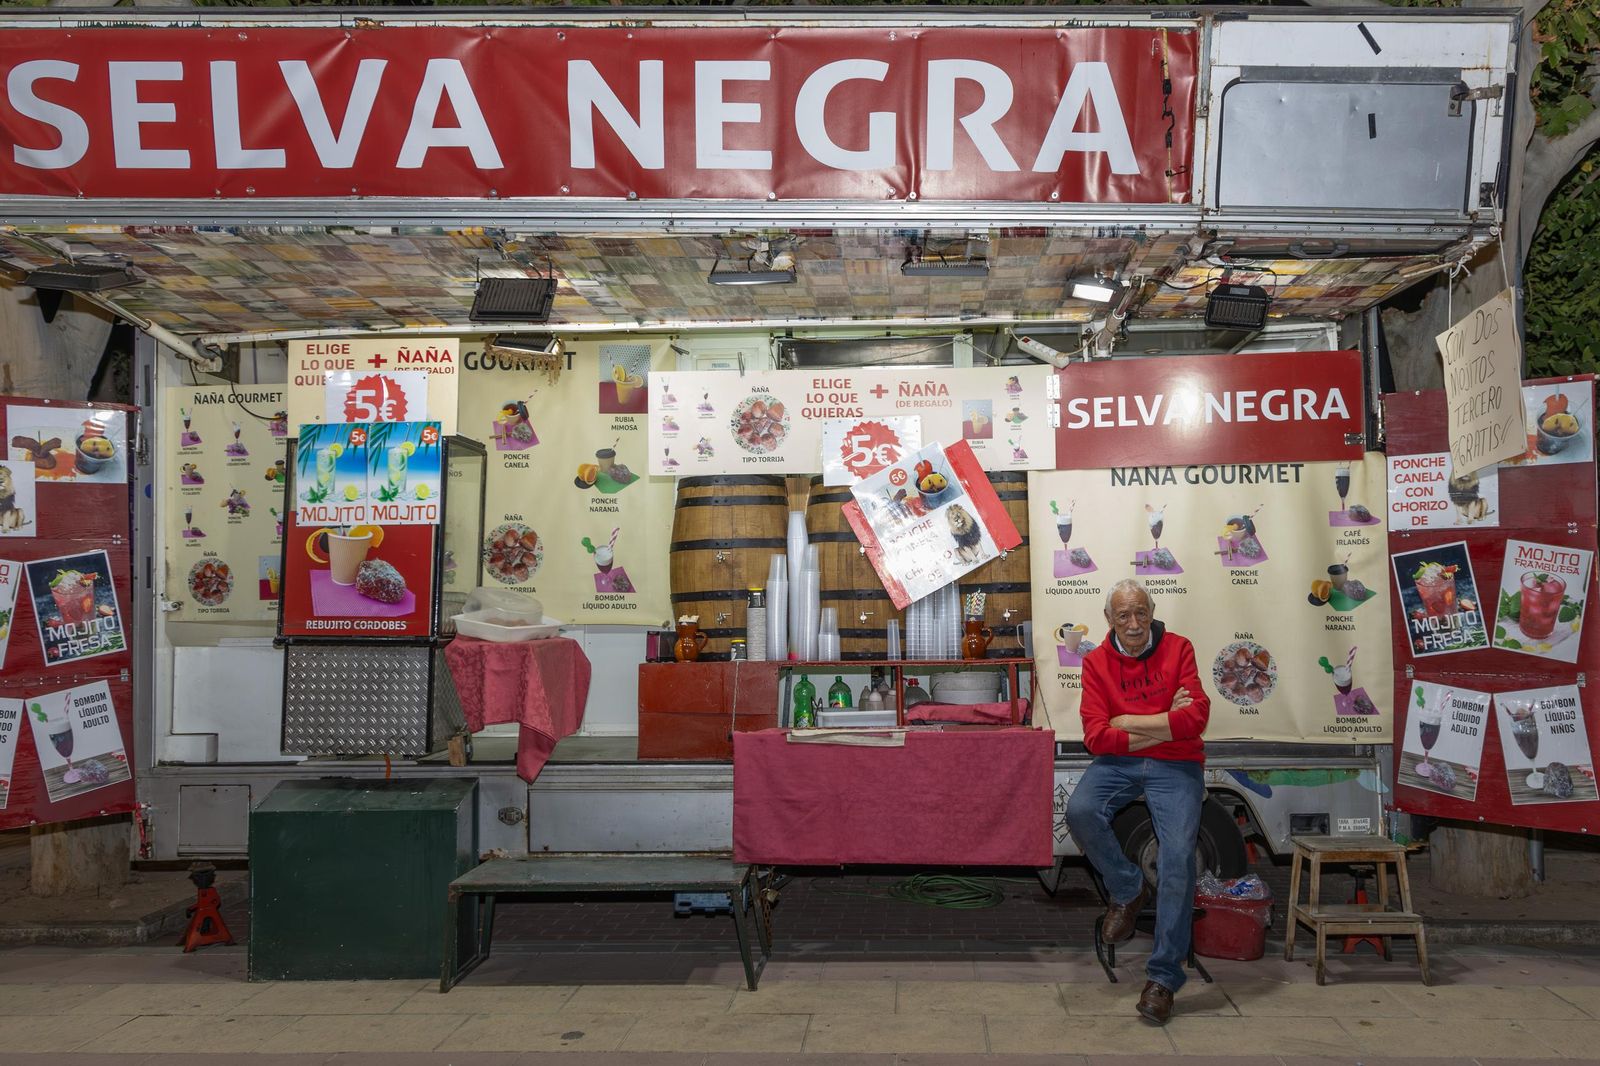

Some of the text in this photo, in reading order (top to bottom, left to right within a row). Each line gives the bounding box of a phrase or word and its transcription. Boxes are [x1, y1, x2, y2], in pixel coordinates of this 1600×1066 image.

[6, 58, 1141, 175] SELVA NEGRA
[1472, 307, 1503, 344] DOS
[306, 343, 350, 355] ELIGE
[397, 346, 453, 363] ÑAÑA
[301, 359, 355, 370] LO QUE
[295, 375, 326, 387] QUIE
[812, 378, 852, 390] ELIGE
[898, 381, 950, 397] ÑAÑA
[194, 392, 283, 405] ÑAÑA GOURMET
[806, 392, 859, 404] LO QUE
[1067, 387, 1350, 430] SELVA NEGRA
[1454, 385, 1503, 427] TERCERO
[801, 407, 864, 420] QUIERAS
[351, 431, 366, 442] 5€
[422, 429, 438, 441] 5€
[850, 434, 893, 468] 5€
[742, 456, 758, 464] TIPO
[1393, 456, 1446, 470] PONCHE
[891, 470, 906, 484] 5€
[1184, 464, 1304, 485] GOURMET
[1394, 473, 1445, 484] CANELA
[1405, 486, 1434, 498] CON
[300, 504, 437, 523] MOJITO MOJITO
[1392, 500, 1448, 513] CHORIZO
[1412, 516, 1429, 526] DE
[1518, 545, 1580, 566] MOJITO
[1514, 557, 1580, 576] FRAMBUESA
[46, 614, 115, 642] MOJITO
[306, 620, 407, 630] REBUJITO CORDOBES
[1412, 610, 1478, 634] MOJITO
[1234, 632, 1254, 640] ÑAÑA
[1422, 630, 1475, 650] FRESA
[58, 634, 113, 658] FRESA
[74, 692, 108, 708] BOMBOM
[1452, 698, 1484, 713] BOMBOM
[83, 714, 110, 730] ADULTO
[1550, 722, 1576, 735] NIÑOS
[1450, 724, 1478, 736] ADULTO
